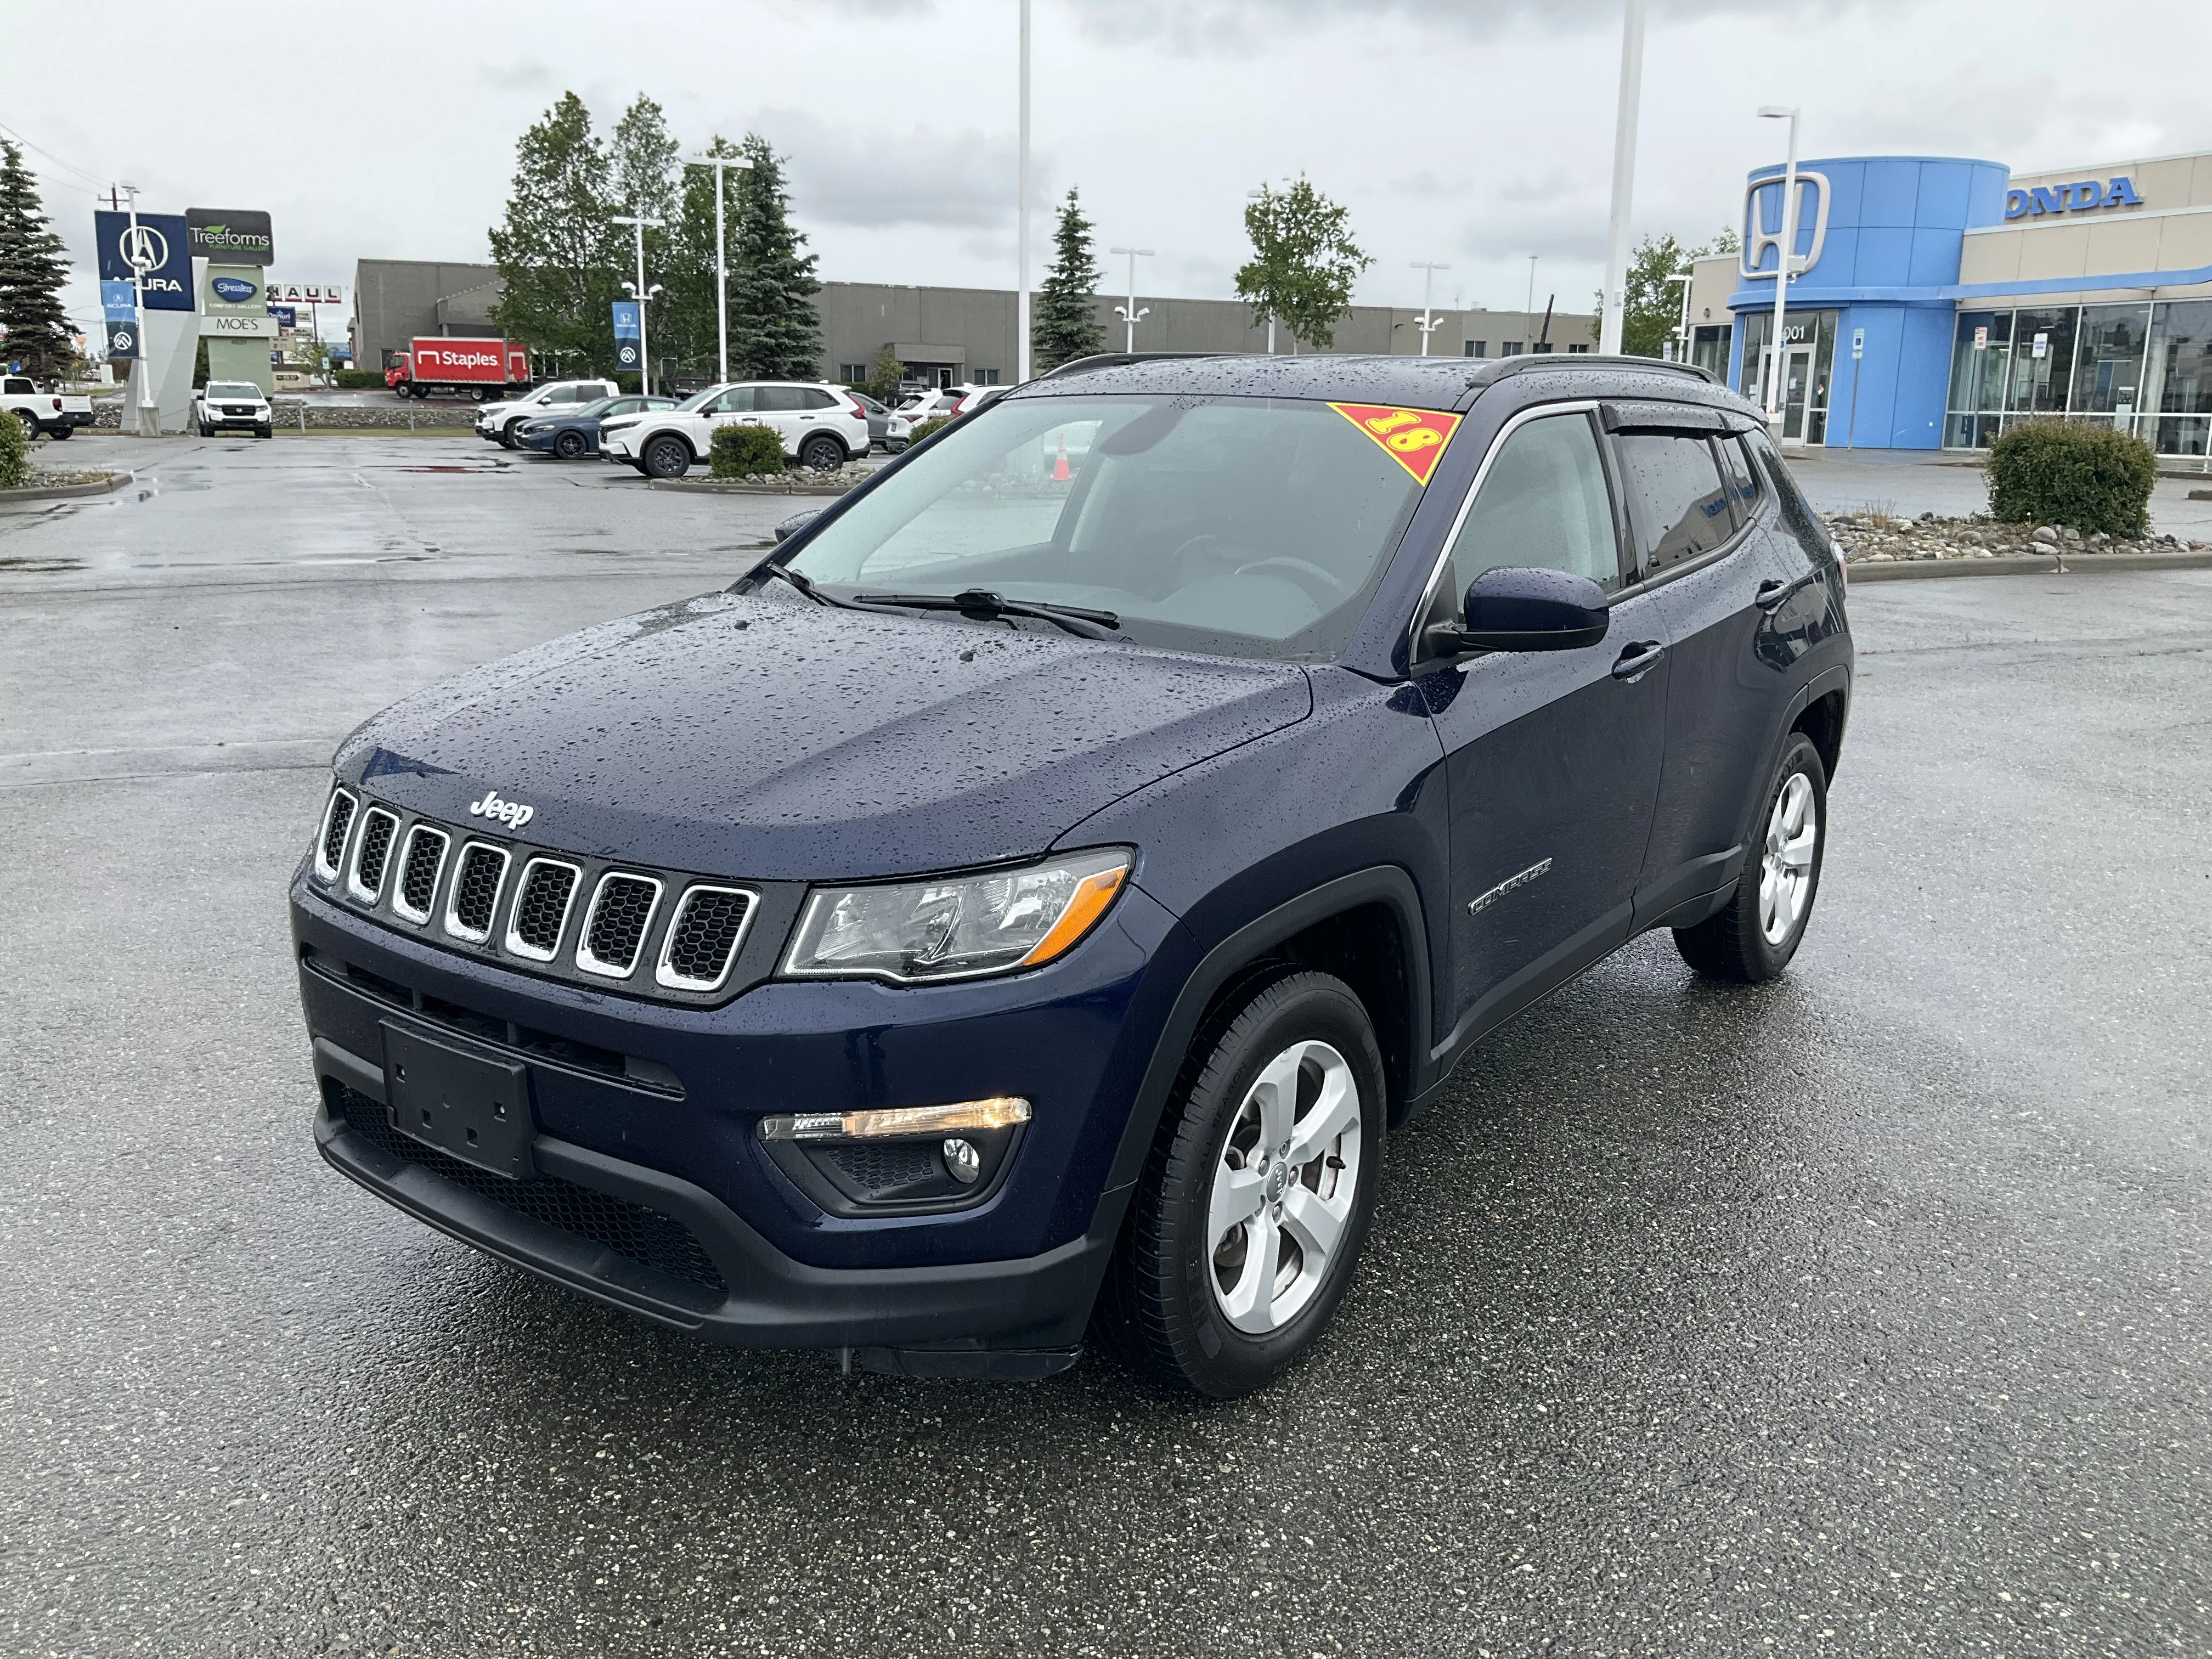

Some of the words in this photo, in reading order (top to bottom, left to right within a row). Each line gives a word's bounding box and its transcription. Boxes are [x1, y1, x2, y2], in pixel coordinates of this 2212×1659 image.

[190, 227, 269, 246] Treeforms
[113, 276, 183, 292] URA
[218, 283, 253, 293] Stressless
[217, 318, 258, 330] MOE'S
[442, 351, 498, 369] Staples
[1365, 411, 1442, 452] 18
[470, 791, 534, 830] Jeep
[1468, 856, 1553, 916] COMPASS
